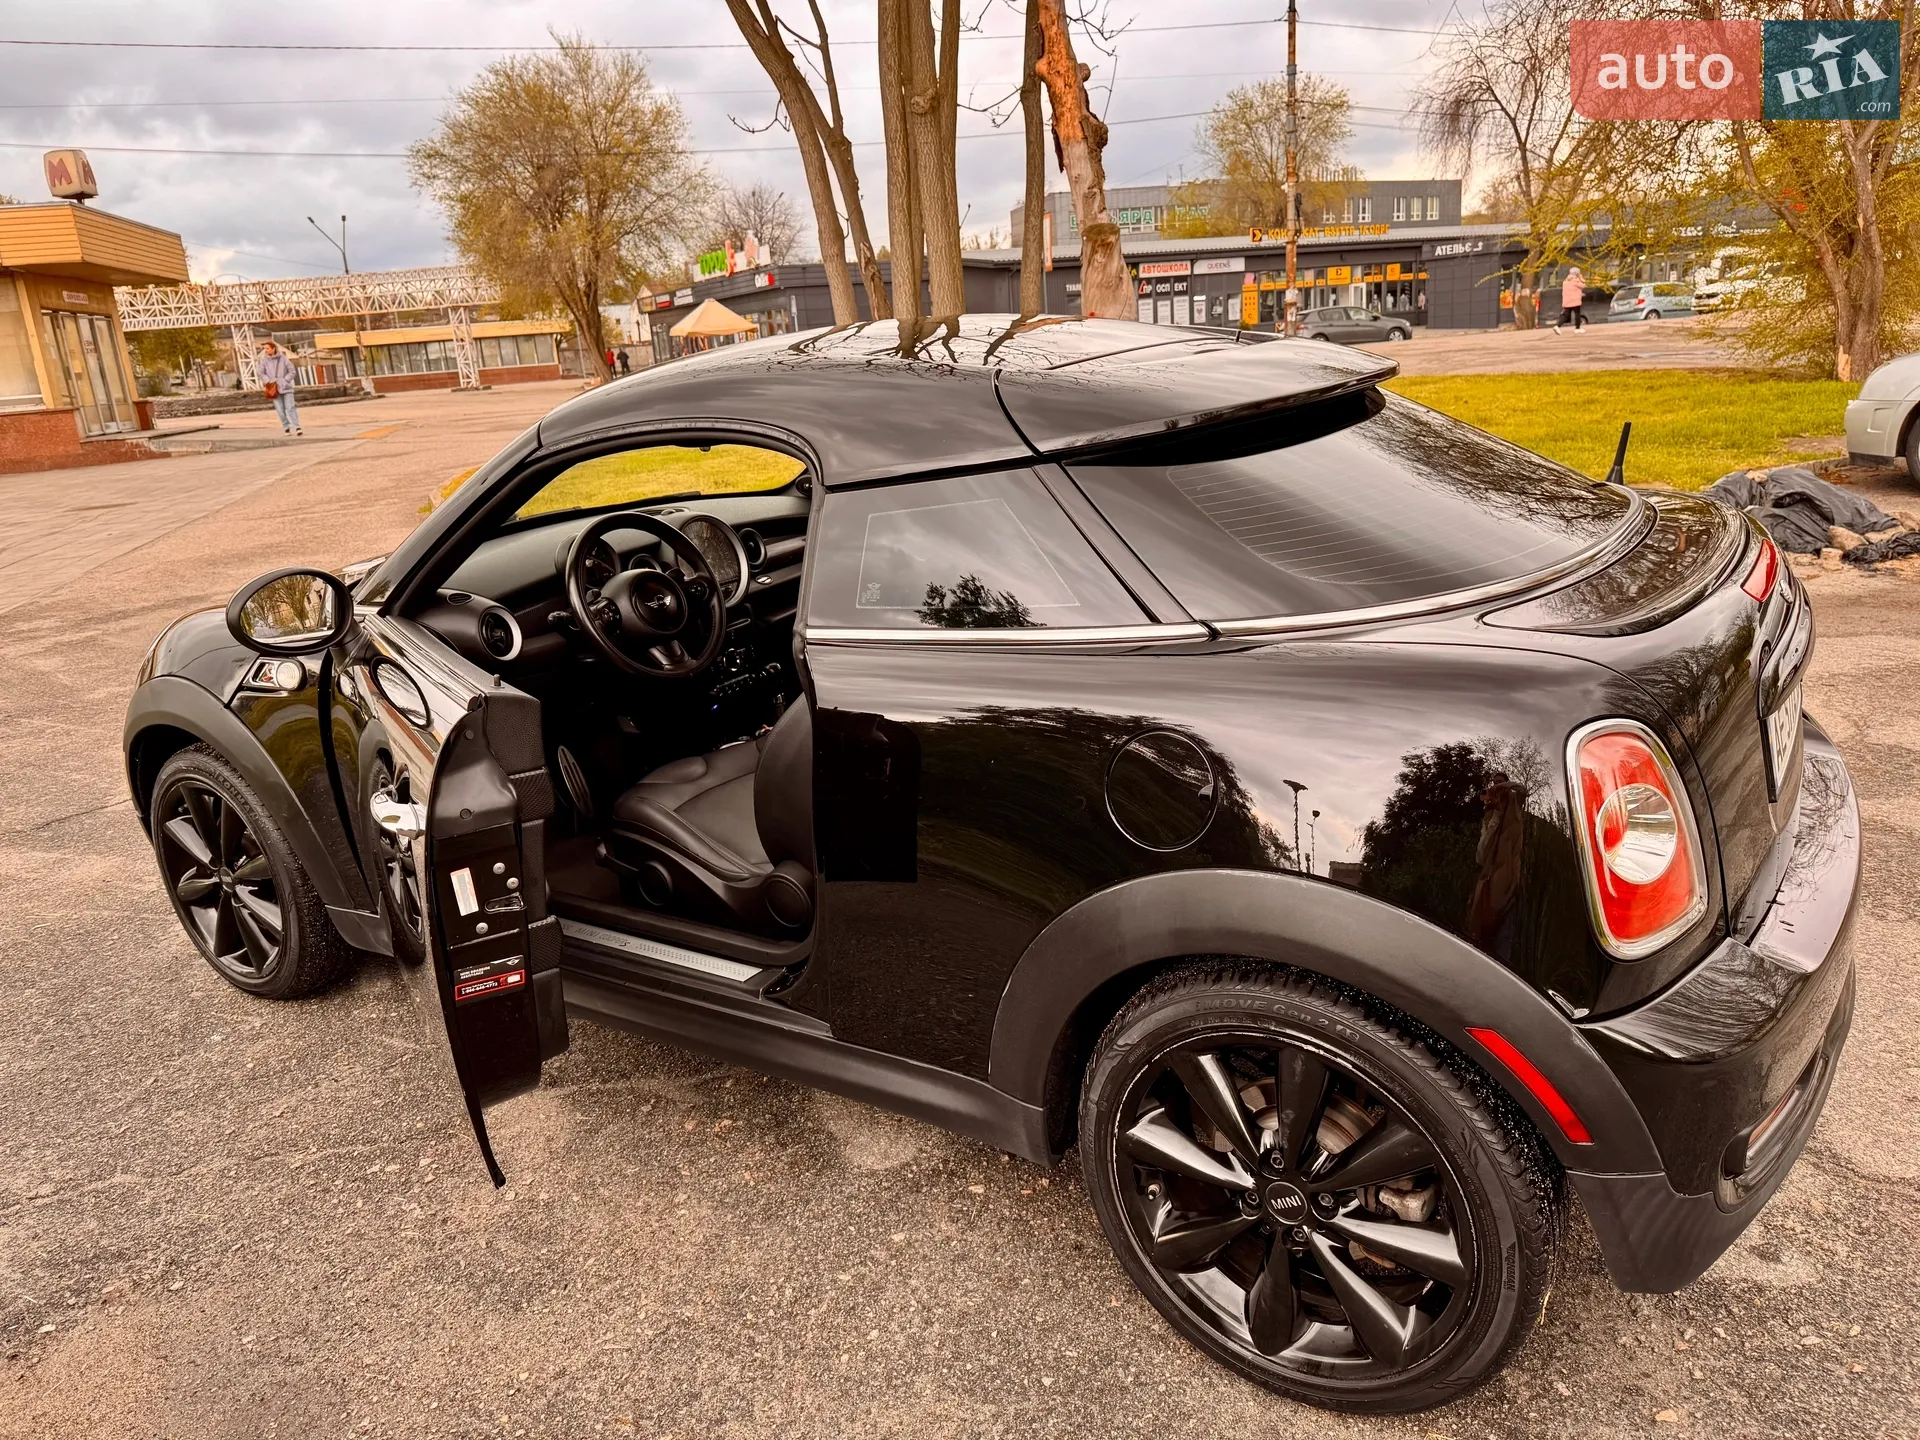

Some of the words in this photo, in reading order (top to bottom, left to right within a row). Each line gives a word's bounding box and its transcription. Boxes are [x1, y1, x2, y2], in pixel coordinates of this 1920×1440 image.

[1435, 242, 1472, 256] АТЕЛЬЄ
[1142, 263, 1189, 274] АВТОШКОЛА
[1273, 1004, 1311, 1023] Gen
[1316, 1018, 1329, 1029] 2
[1270, 1194, 1302, 1210] MINI
